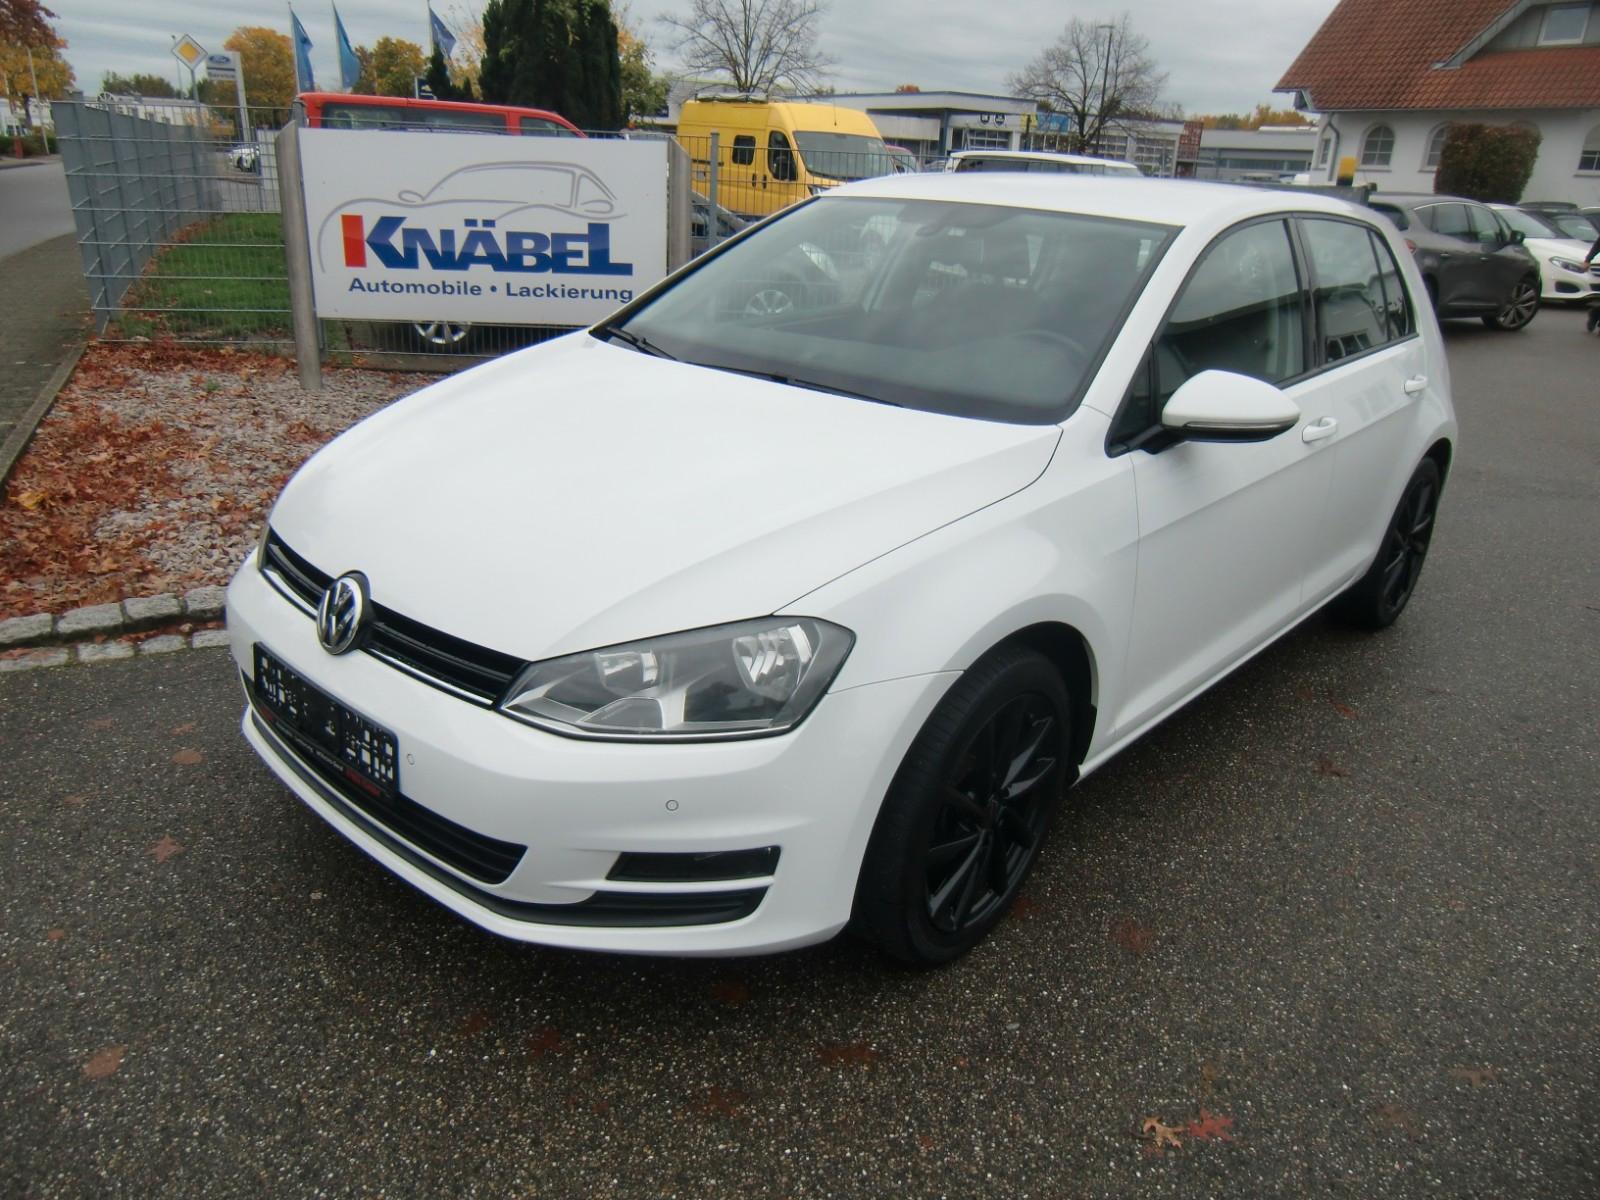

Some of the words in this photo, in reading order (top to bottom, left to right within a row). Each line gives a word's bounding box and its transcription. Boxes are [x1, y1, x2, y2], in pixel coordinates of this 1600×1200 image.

[341, 215, 633, 276] KNÄBEL
[348, 278, 482, 296] Automobile
[506, 282, 633, 304] Lackierung
